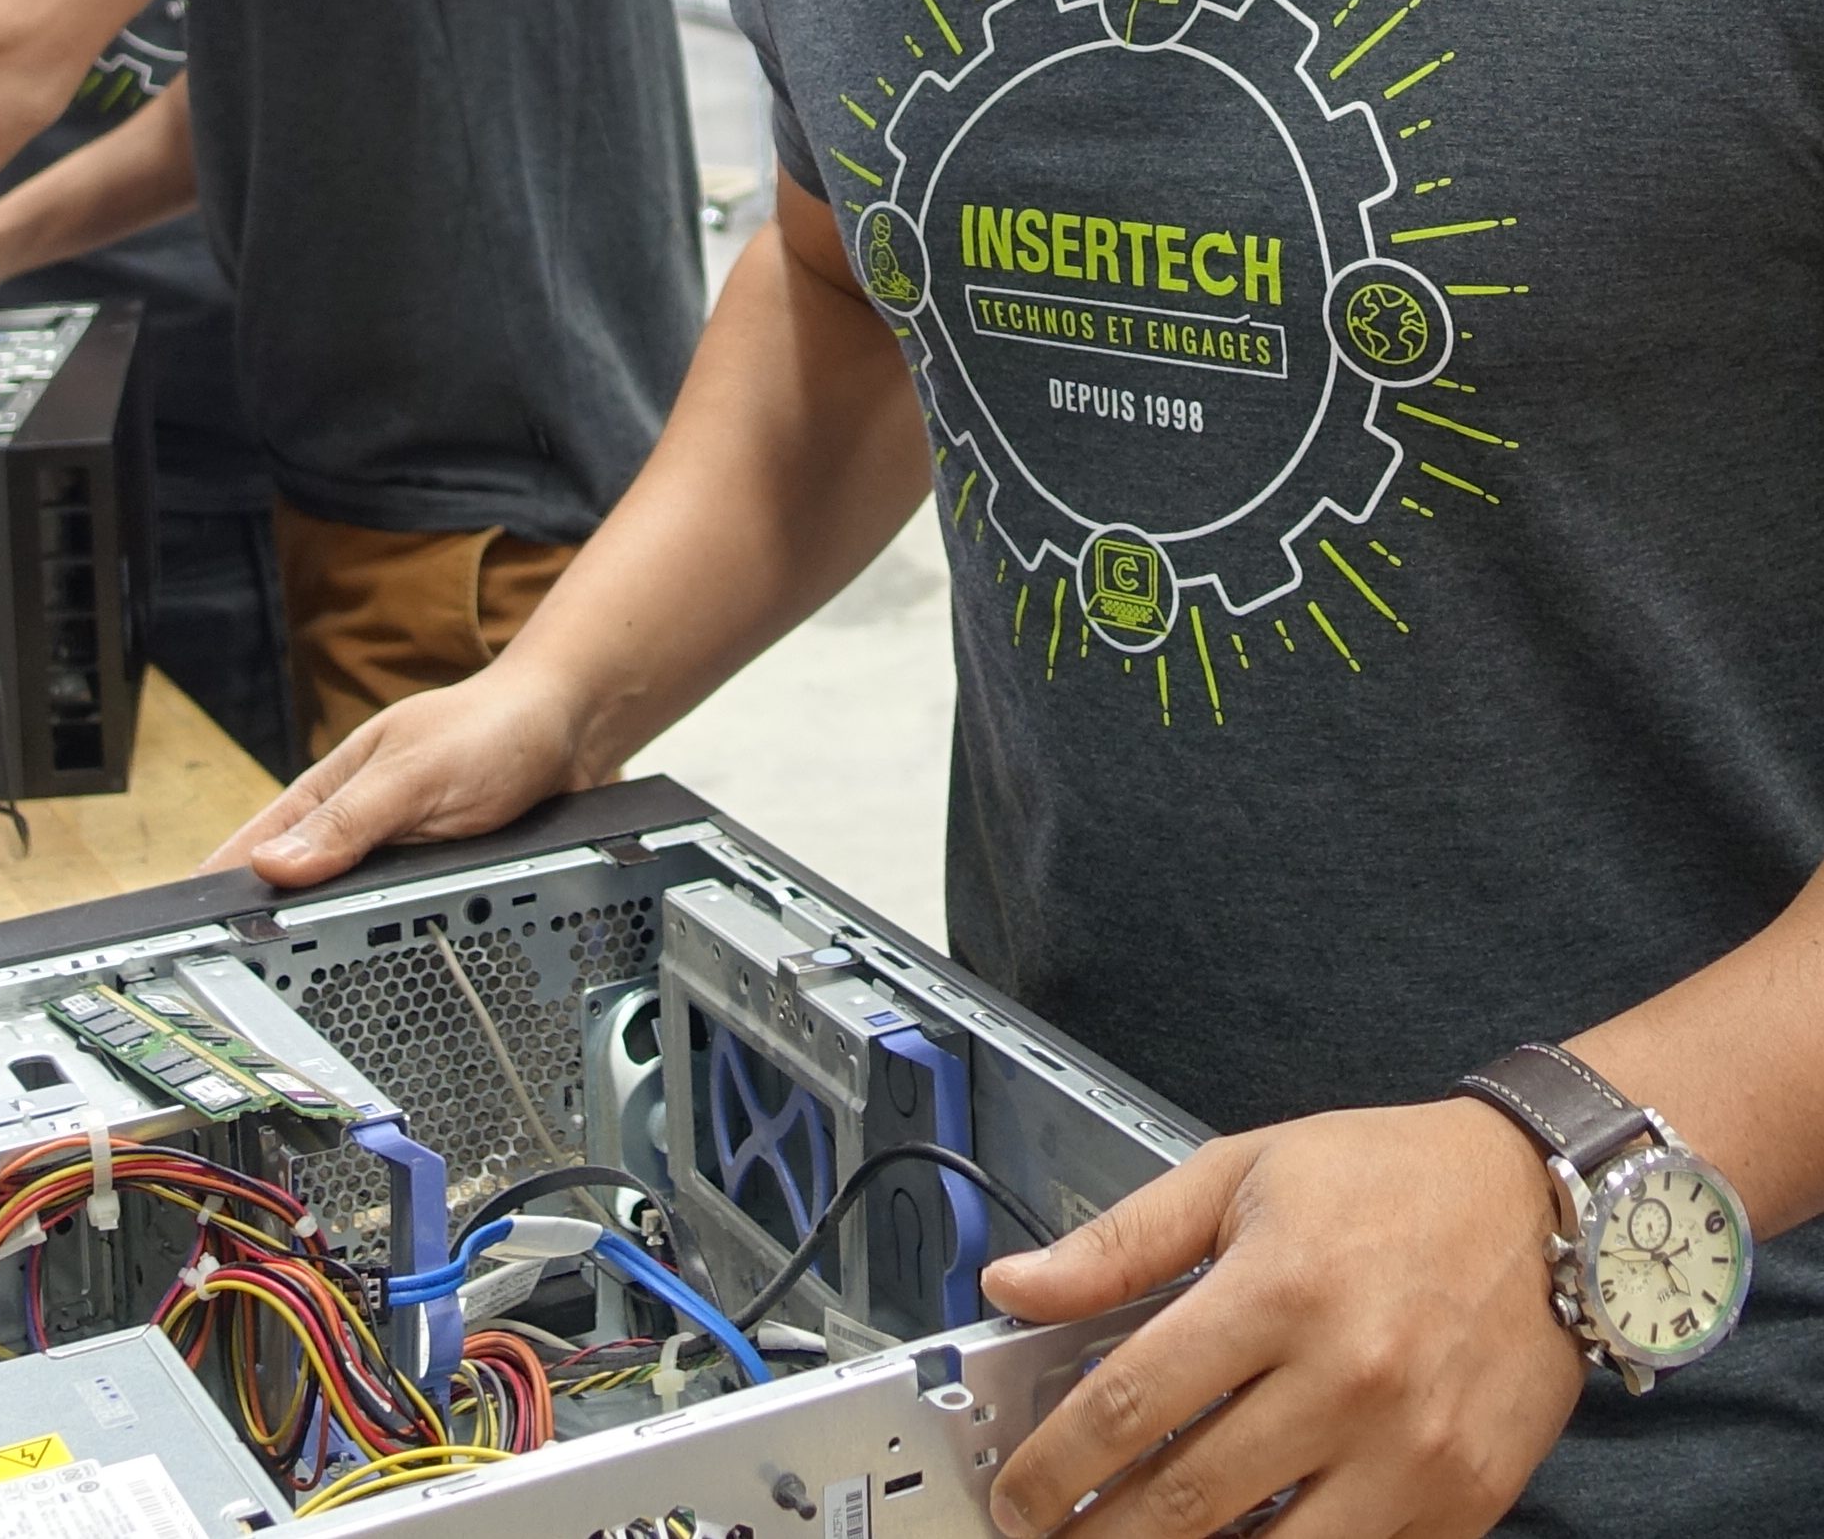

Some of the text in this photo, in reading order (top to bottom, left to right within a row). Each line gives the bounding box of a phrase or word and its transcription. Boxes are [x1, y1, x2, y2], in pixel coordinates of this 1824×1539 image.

[961, 204, 1282, 306] INSERTECH
[979, 299, 1272, 366] TECHNOS ET ENGAGES
[1049, 378, 1205, 433] DEPUIS 1998
